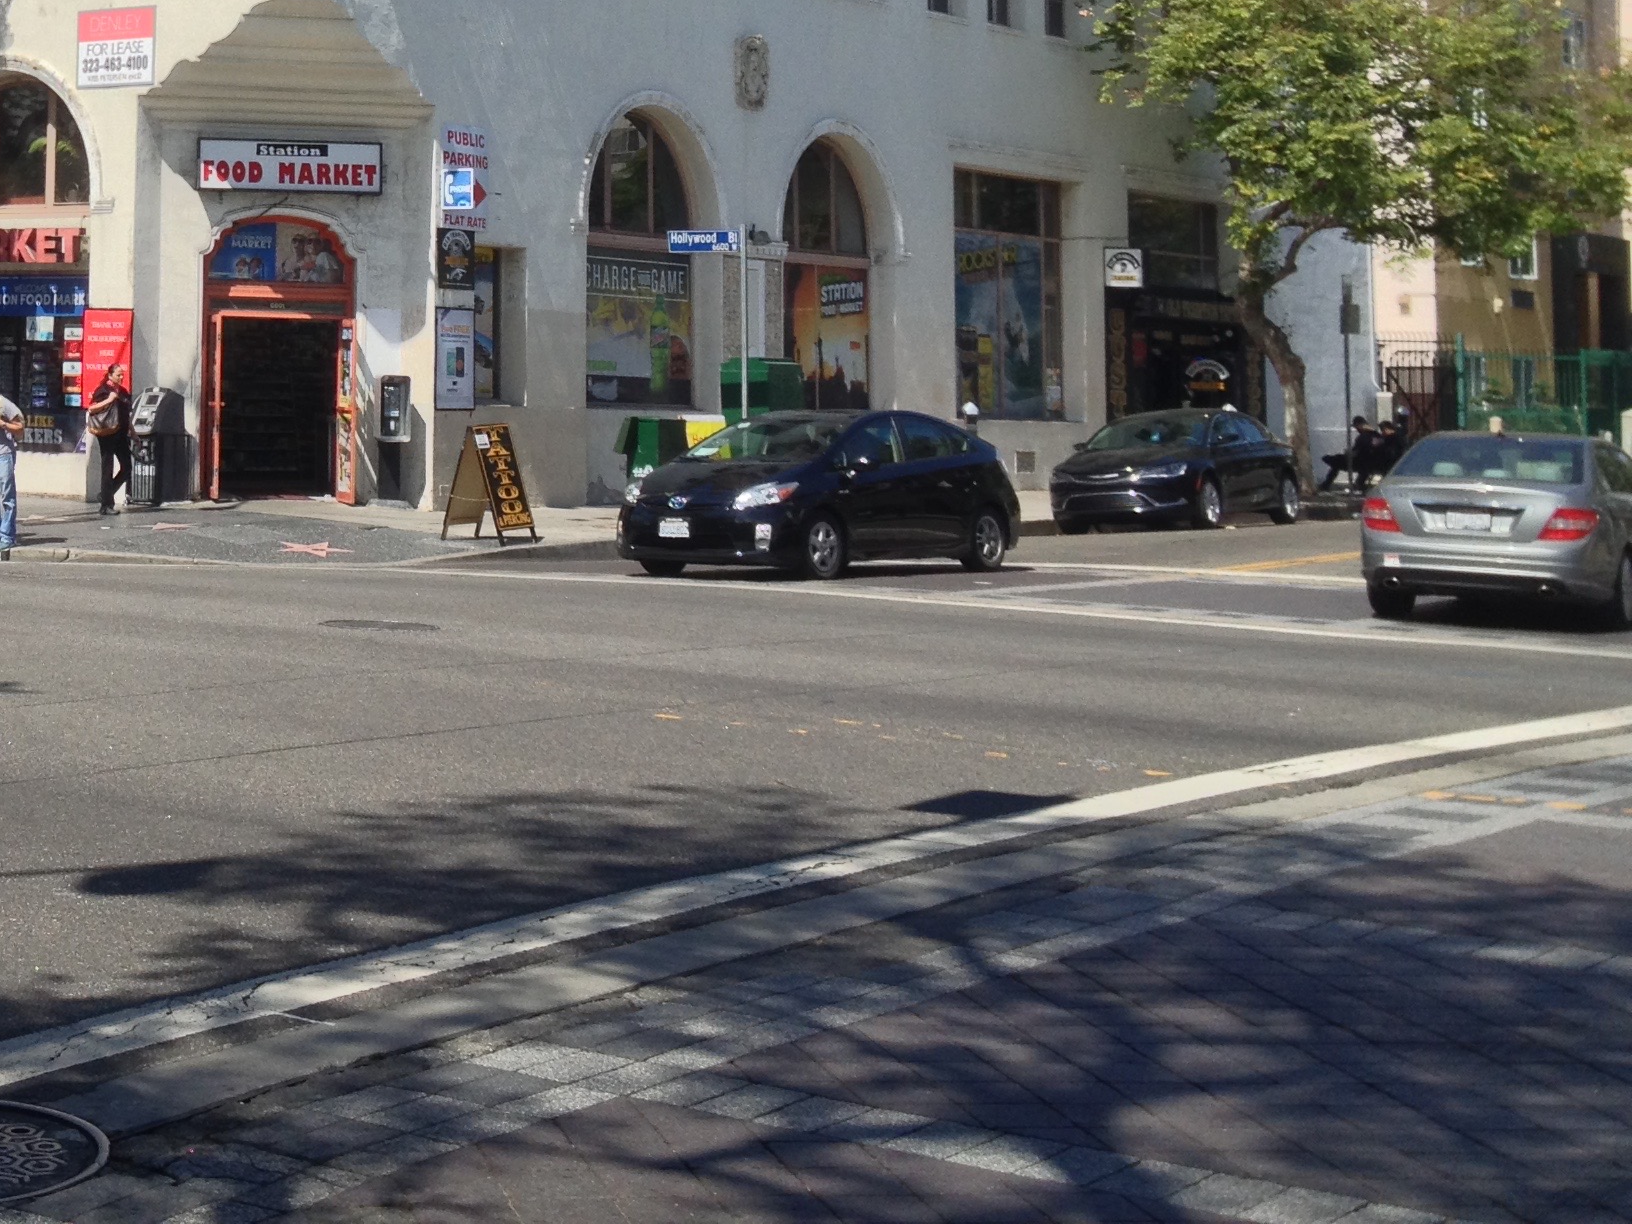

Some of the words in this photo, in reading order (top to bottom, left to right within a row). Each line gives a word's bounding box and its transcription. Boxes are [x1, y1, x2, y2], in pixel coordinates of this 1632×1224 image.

[89, 14, 142, 33] DENLEY
[86, 43, 108, 57] FOR
[111, 41, 144, 56] LEASE
[82, 55, 148, 74] 323-463-4100
[447, 130, 485, 149] PUBLIC
[259, 145, 321, 157] Station
[443, 150, 488, 170] PARKING
[203, 160, 263, 184] FOOD
[278, 162, 377, 187] MARKET
[444, 213, 464, 227] FLAT
[467, 216, 486, 230] RATE
[231, 239, 271, 249] MARKET
[671, 232, 717, 247] Hollywood
[650, 269, 685, 295] GAME
[20, 293, 51, 306] FOOD
[821, 281, 863, 303] STATION
[26, 415, 55, 428] LIKE
